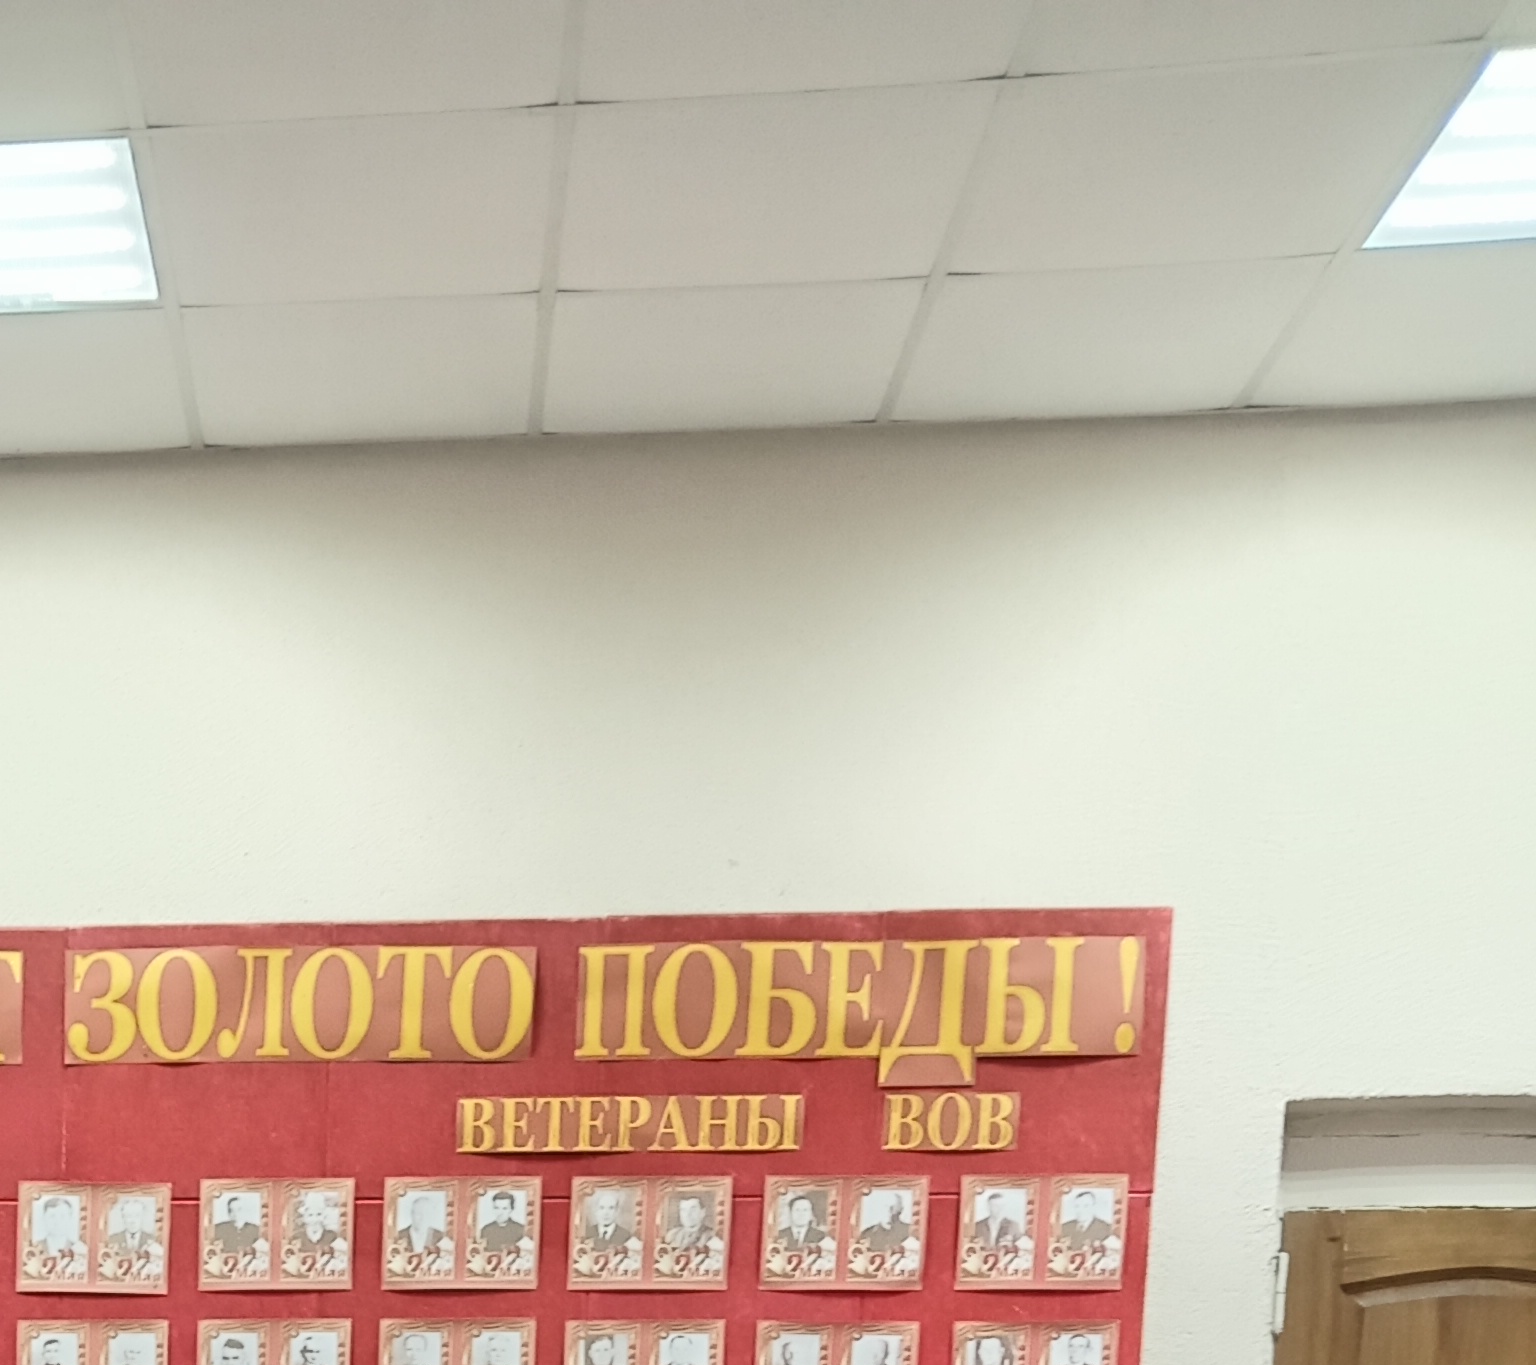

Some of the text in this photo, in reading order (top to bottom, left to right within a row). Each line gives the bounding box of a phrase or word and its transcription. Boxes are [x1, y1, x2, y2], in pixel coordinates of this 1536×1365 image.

[66, 946, 534, 1064] ЗОЛОТО
[457, 1092, 1017, 1153] ВЕТЕРАНЫ ВОВ
